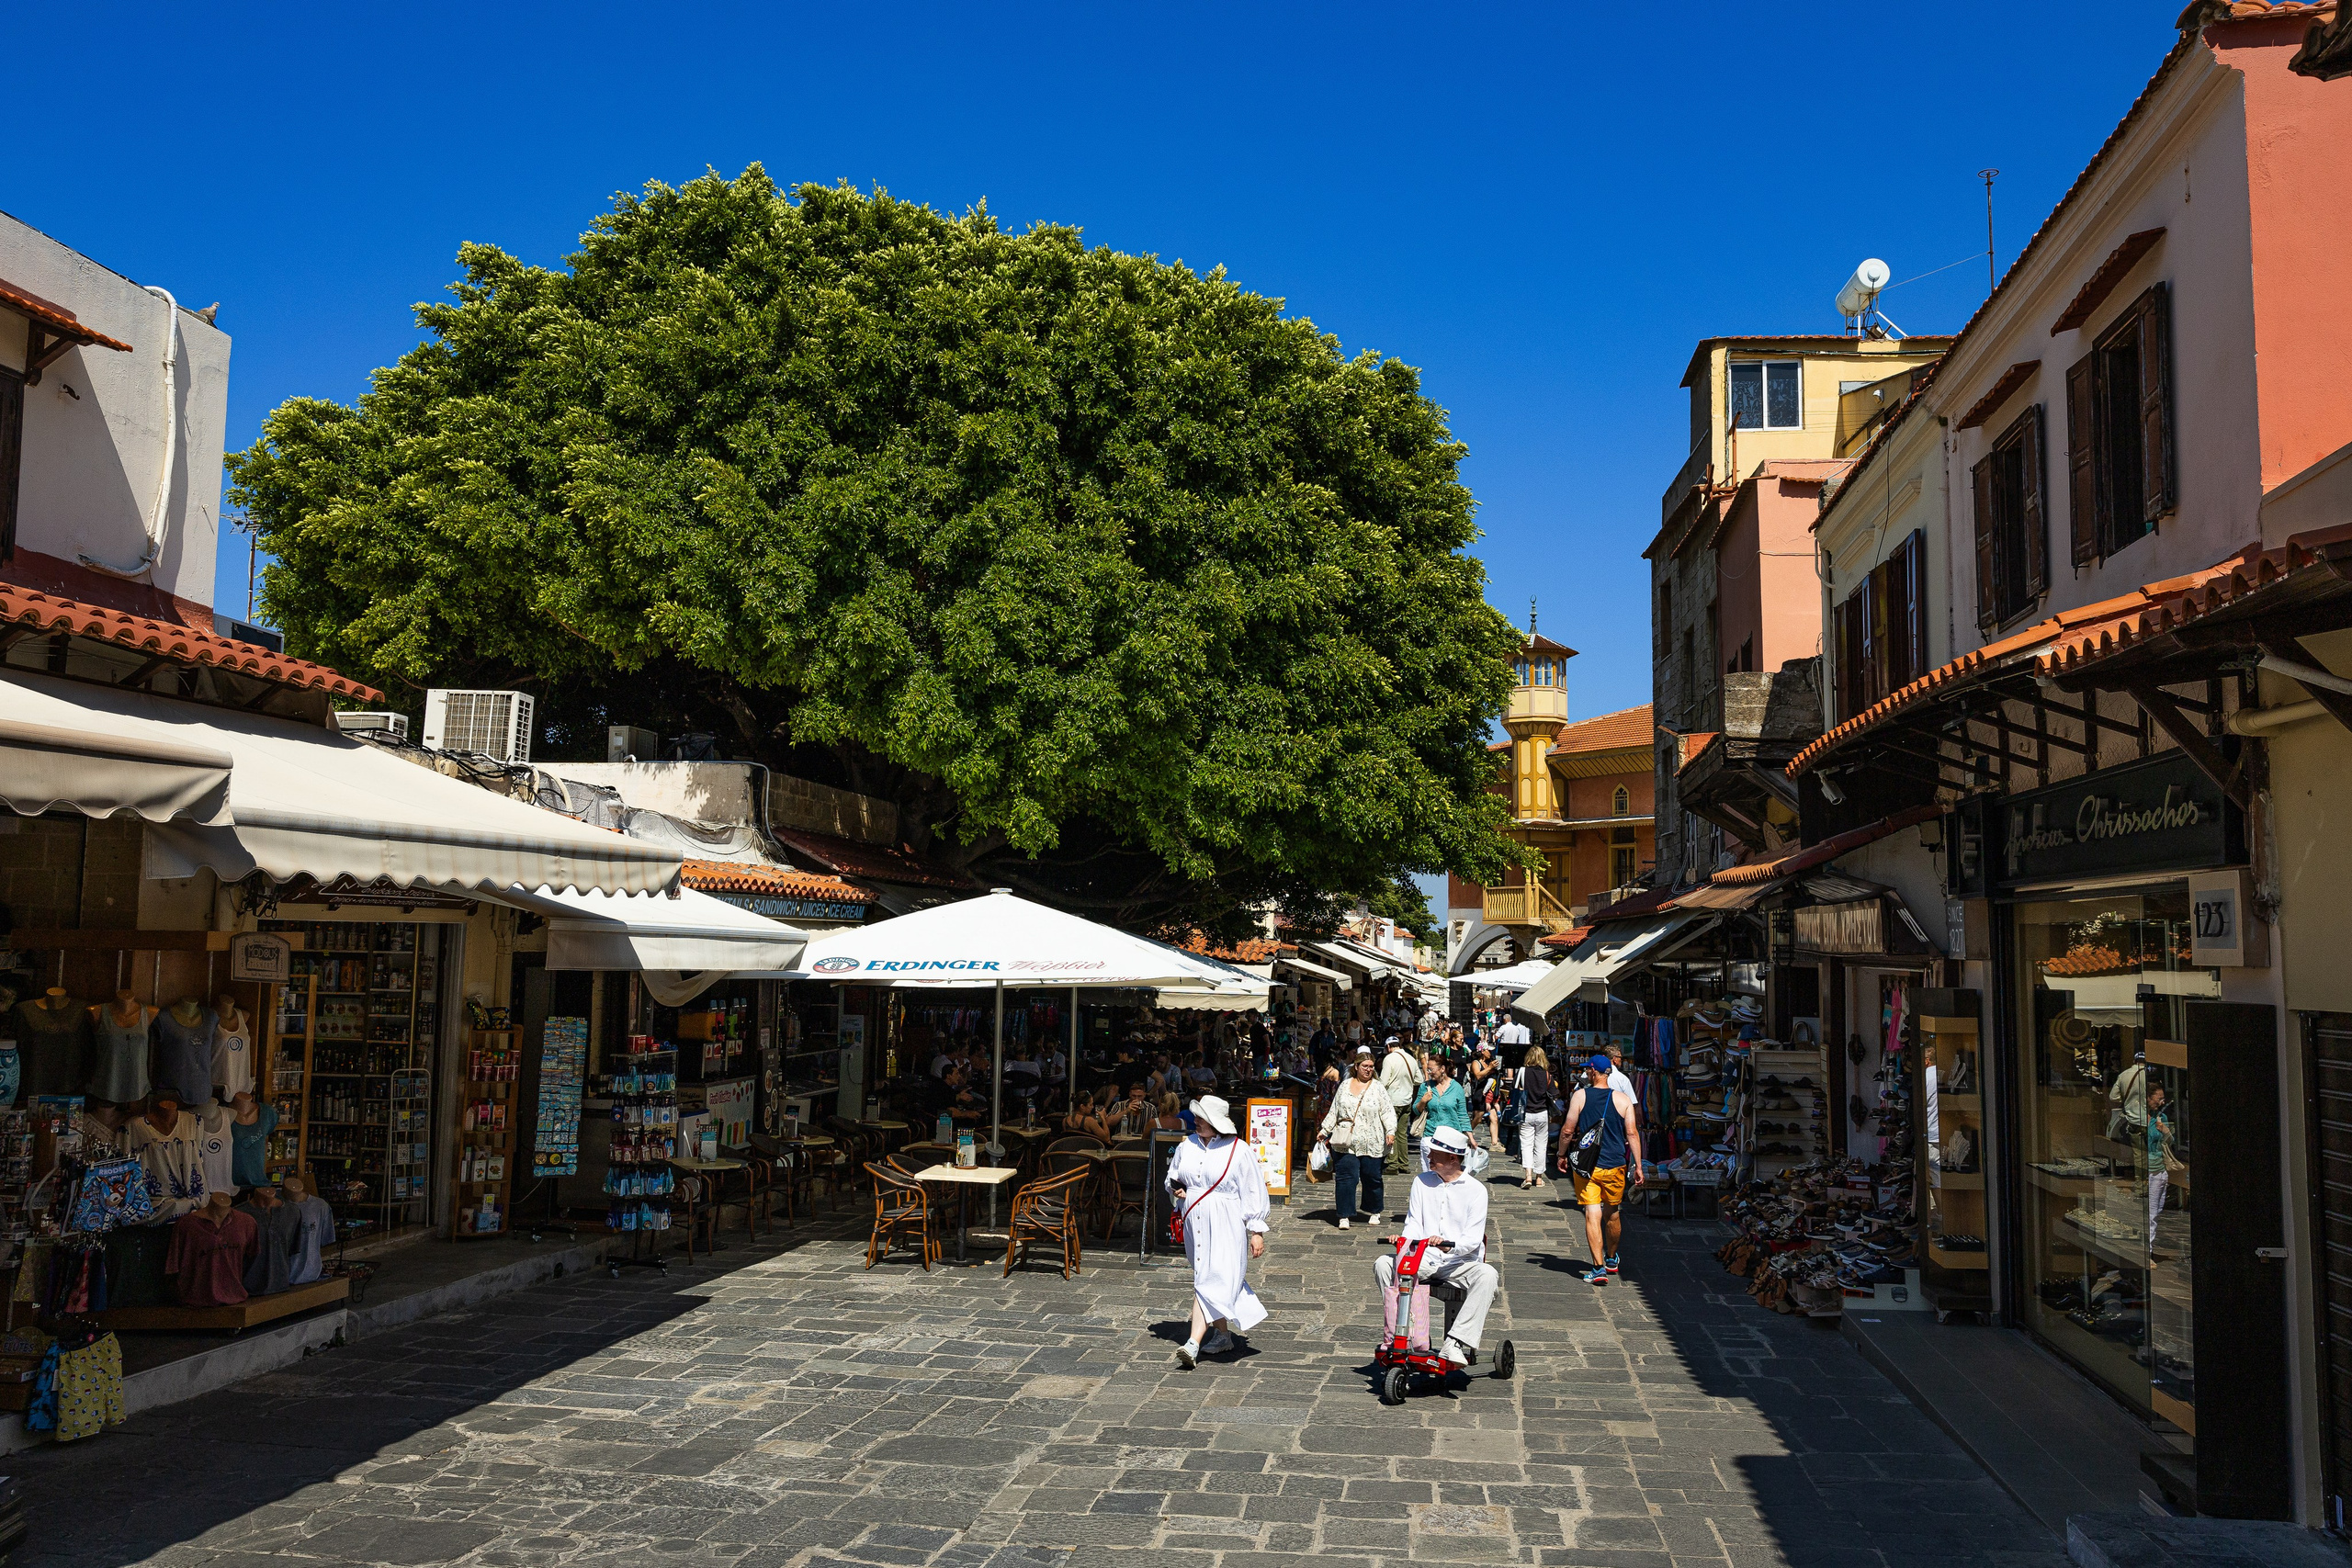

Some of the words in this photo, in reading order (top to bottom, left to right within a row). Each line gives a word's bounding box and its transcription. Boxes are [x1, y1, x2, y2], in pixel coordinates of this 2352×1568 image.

[2075, 784, 2199, 843] Chrissochos
[753, 898, 797, 916] SANDWICH
[799, 902, 826, 917] JUICES
[828, 904, 842, 918] ICE
[840, 905, 865, 919] CREAM
[2194, 901, 2223, 938] 123
[1840, 908, 1878, 945] ΧΡΗΣΤΟΥ
[865, 960, 1001, 972] ERDINGER
[98, 1165, 129, 1175] RHODES
